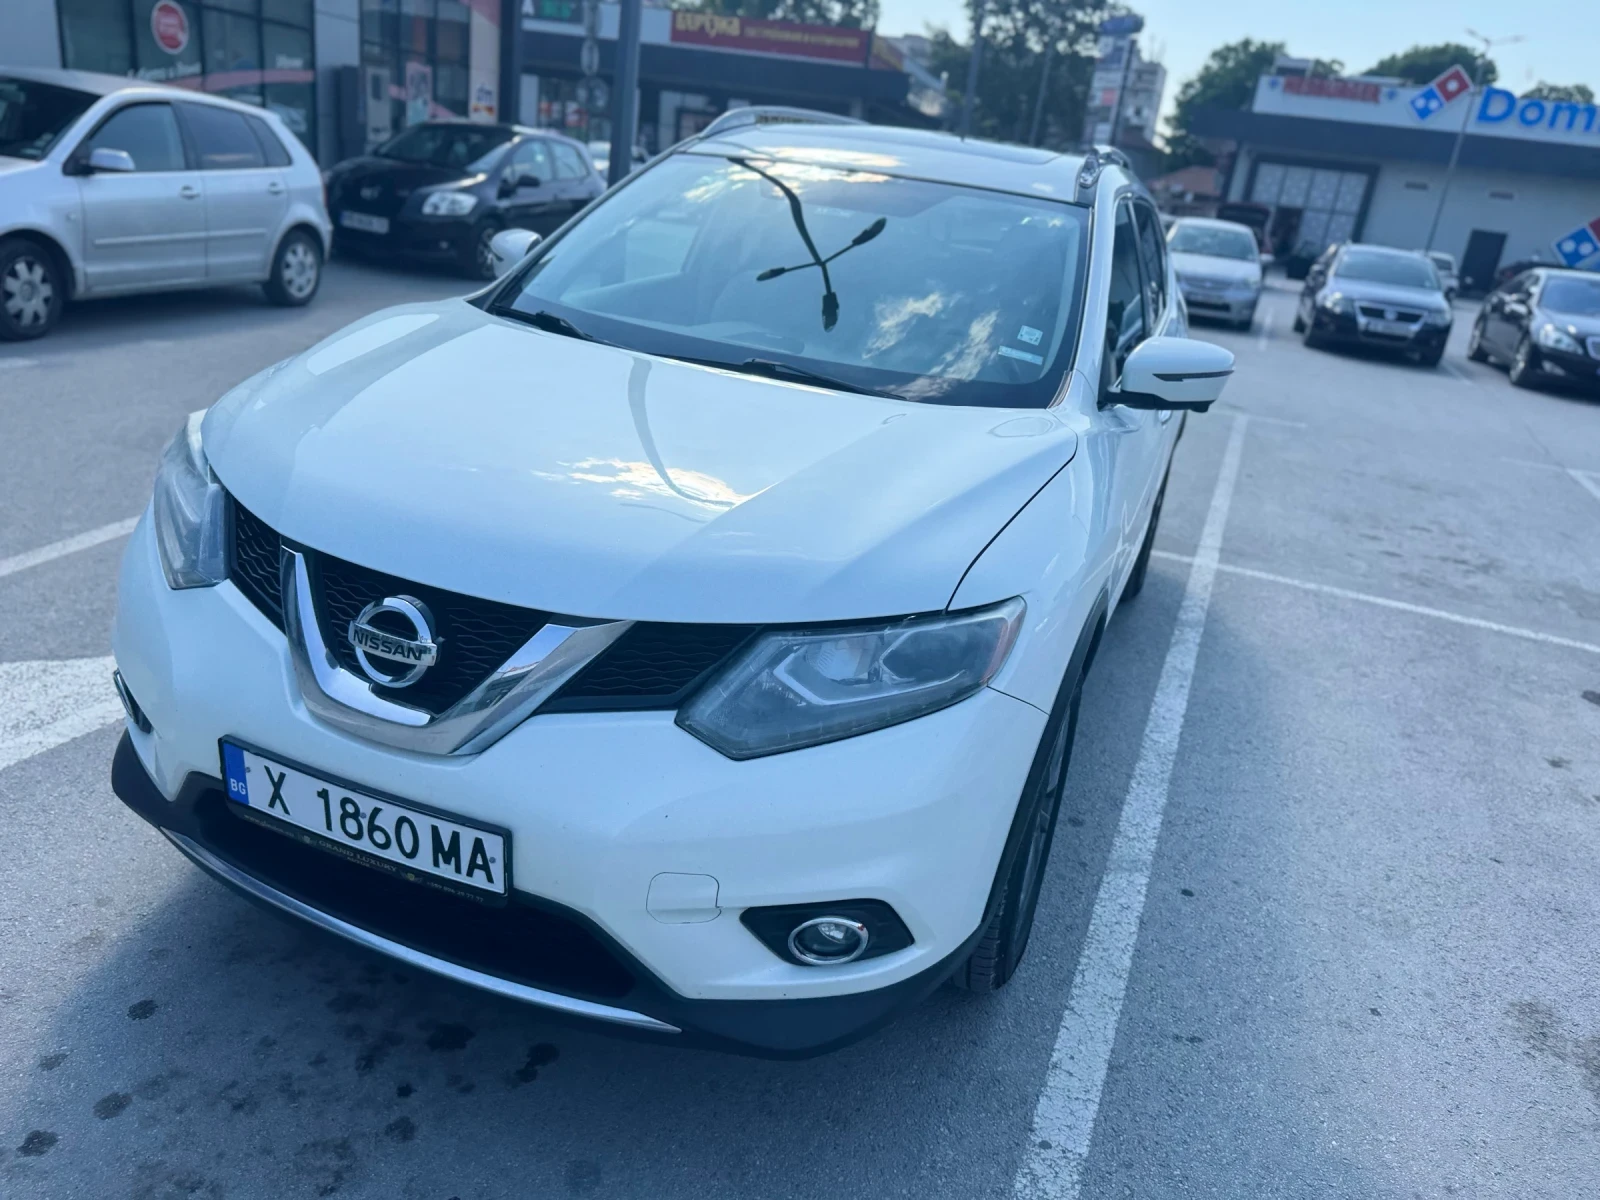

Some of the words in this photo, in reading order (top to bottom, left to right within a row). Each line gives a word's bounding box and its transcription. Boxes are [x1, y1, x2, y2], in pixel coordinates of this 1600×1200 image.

[1477, 85, 1600, 133] Dom
[353, 628, 422, 661] NISSAN
[230, 778, 247, 795] BG
[264, 764, 291, 815] X
[317, 787, 420, 860] 1860
[430, 823, 495, 884] MA
[319, 840, 354, 857] GRAND
[356, 852, 397, 873] LUXURY
